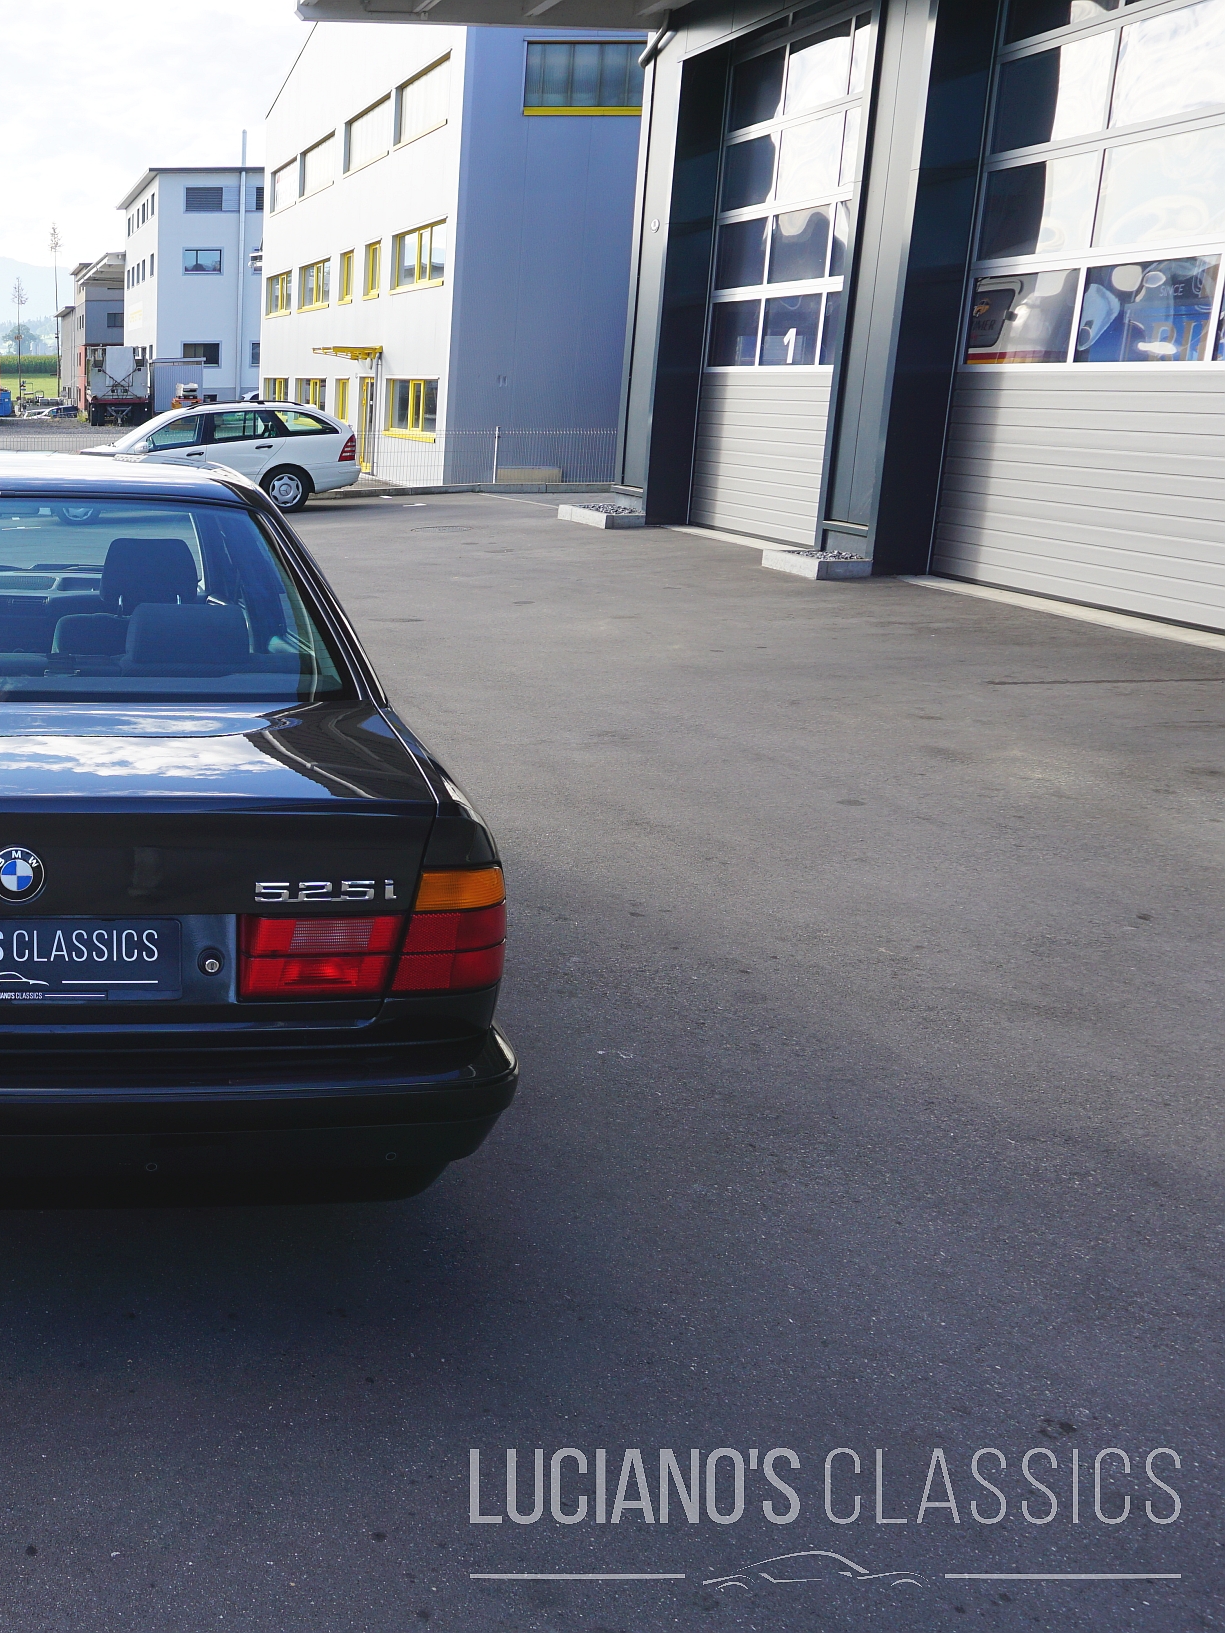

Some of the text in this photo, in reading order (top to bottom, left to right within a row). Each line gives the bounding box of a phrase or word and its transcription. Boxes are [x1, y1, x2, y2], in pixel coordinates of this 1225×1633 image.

[1160, 284, 1185, 297] SINCE
[783, 327, 797, 364] 1
[255, 879, 397, 902] 525i
[12, 929, 158, 962] CLASSICS
